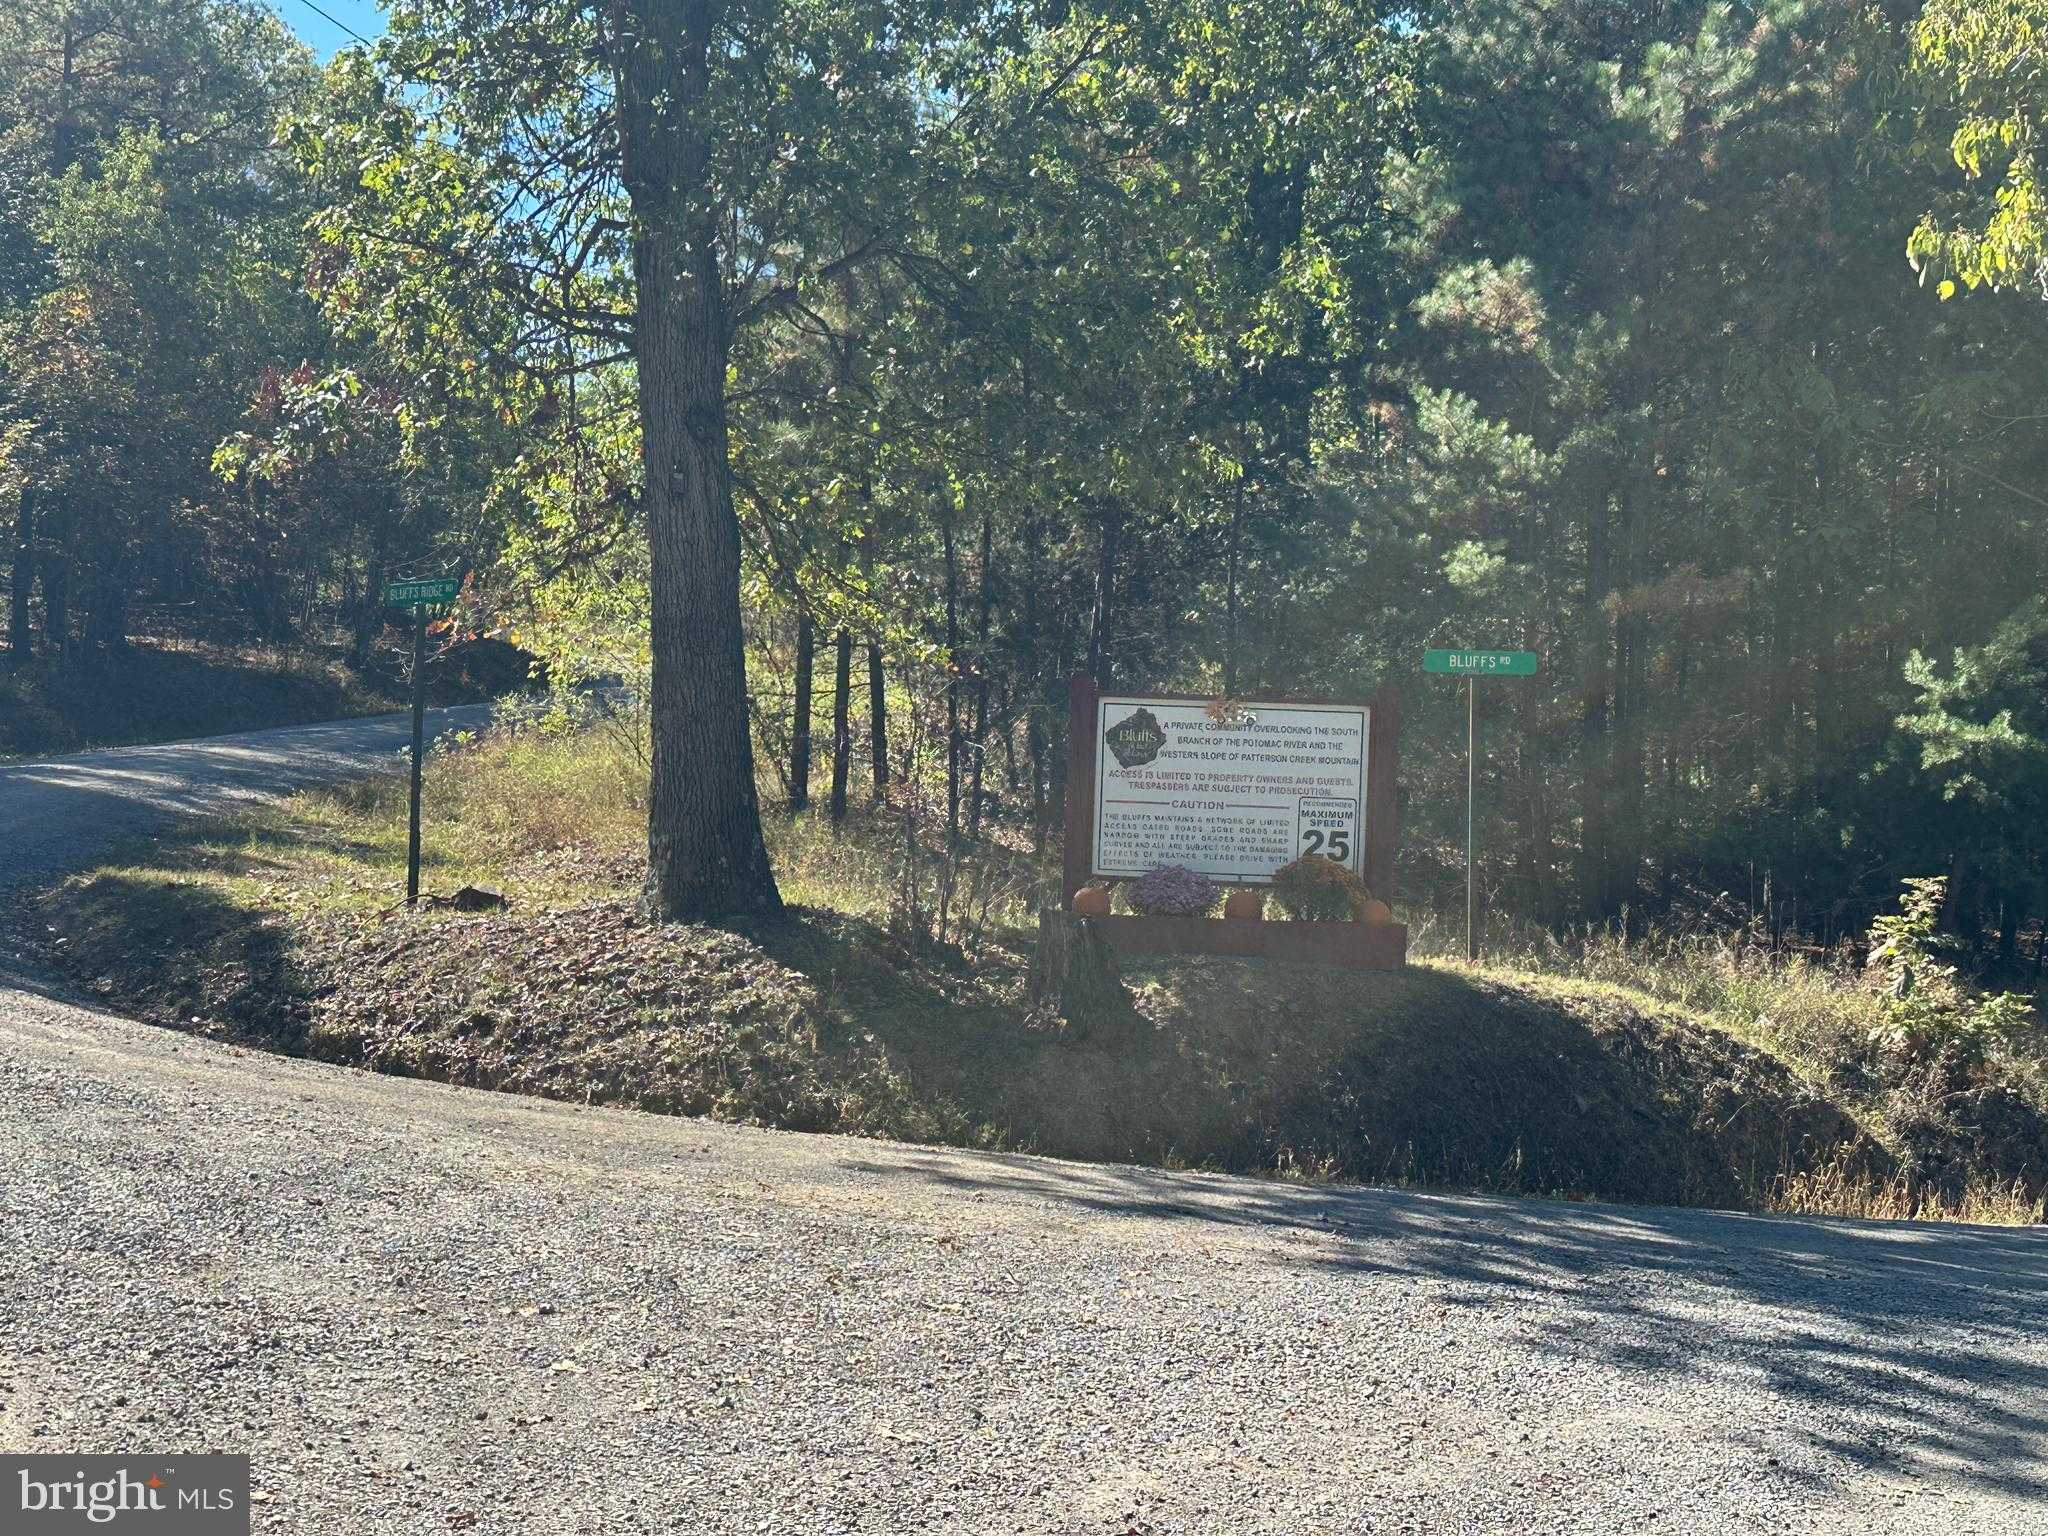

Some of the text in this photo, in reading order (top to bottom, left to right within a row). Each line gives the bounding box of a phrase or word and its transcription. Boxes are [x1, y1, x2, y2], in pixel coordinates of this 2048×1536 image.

[390, 583, 454, 601] BLUFFS RIDGE RD
[1449, 654, 1511, 668] BLUFFS RD
[1163, 721, 1169, 729] A
[1171, 721, 1202, 731] PRIVATE
[1255, 724, 1312, 735] OVERLOOKING
[1314, 726, 1329, 735] THE
[1331, 727, 1359, 737] SOUTH
[1177, 735, 1343, 751] BRANCH OF THE POTOMAC RIVER AND THE
[1160, 750, 1199, 760] WESTERN
[1201, 751, 1226, 761] SLOPE
[1228, 752, 1239, 761] OF
[1241, 752, 1287, 763] PATTERSON
[1289, 754, 1316, 764] CREEK
[1318, 755, 1359, 766] MOUNTAIN
[1108, 768, 1142, 779] ACCESS
[1145, 770, 1154, 780] IS
[1156, 770, 1191, 780] LIMITED
[1194, 772, 1205, 781] TO
[1208, 773, 1254, 784] PROPERTY
[1255, 774, 1295, 785] OWNERS
[1296, 775, 1314, 785] AND
[1129, 780, 1190, 791] TRESPASSERS
[1192, 782, 1209, 792] ARE
[1211, 783, 1252, 794] SUBJECT
[1254, 785, 1266, 794] TO
[1171, 800, 1225, 811] CAUTION
[1205, 817, 1244, 825] NETWORK
[1246, 818, 1256, 826] OF
[1301, 810, 1353, 820] MAXIMUM
[1310, 819, 1344, 828] SPEED
[1239, 827, 1268, 836] ROADS
[1302, 829, 1350, 862] 25
